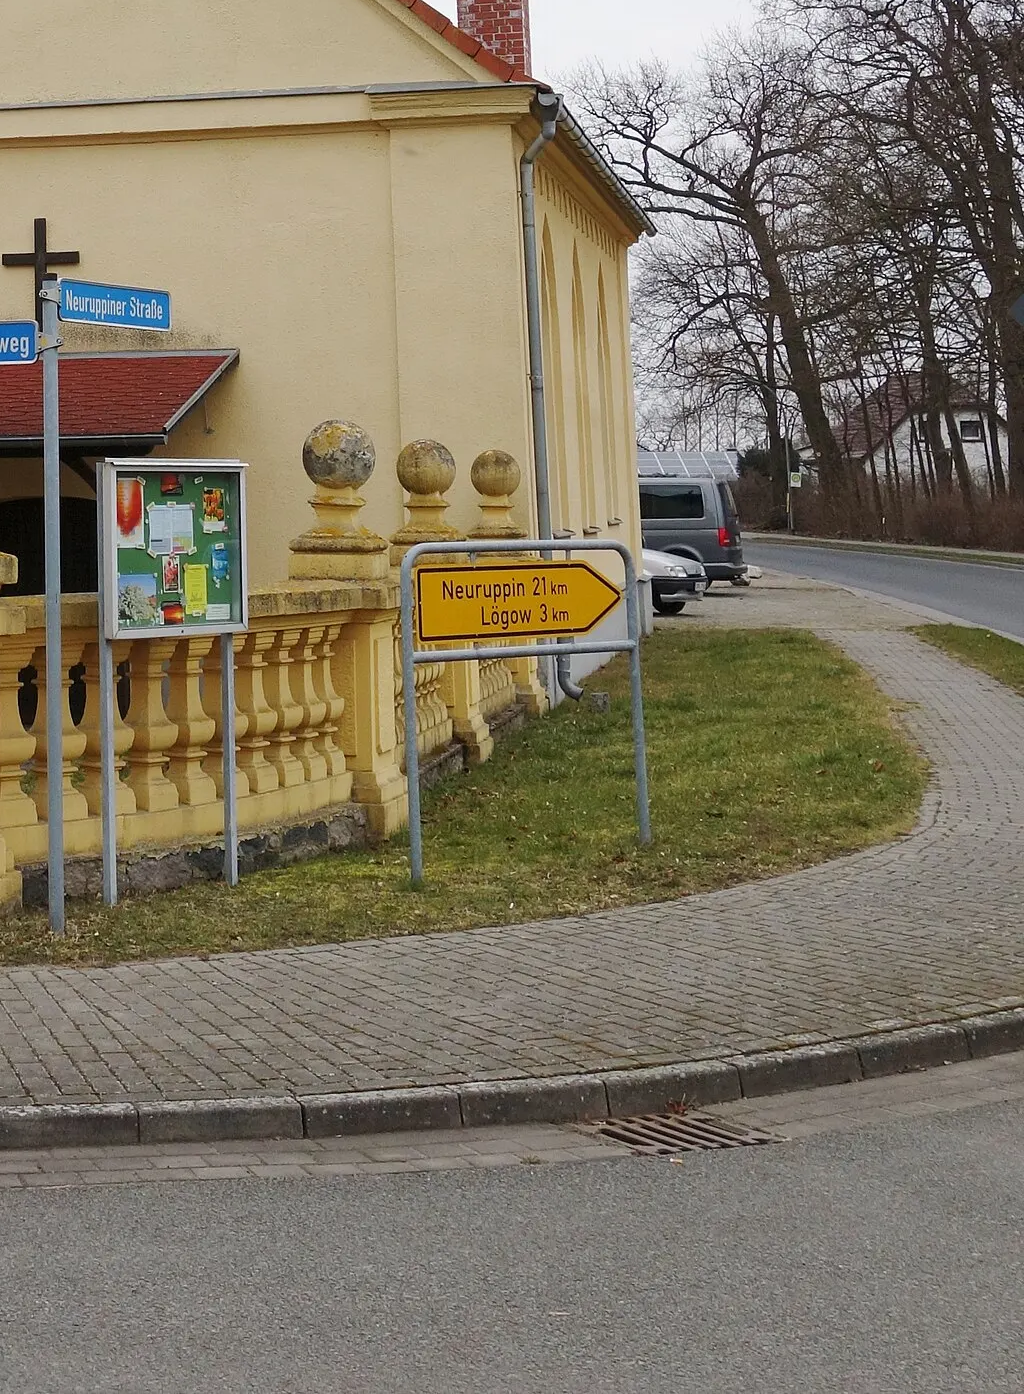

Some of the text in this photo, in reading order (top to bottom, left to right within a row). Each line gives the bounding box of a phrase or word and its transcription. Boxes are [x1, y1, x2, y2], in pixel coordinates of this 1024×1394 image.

[66, 289, 163, 320] Neuruppiner Straße
[442, 577, 568, 603] Neuruppin 21 km
[481, 604, 569, 629] Lögow 3 km
